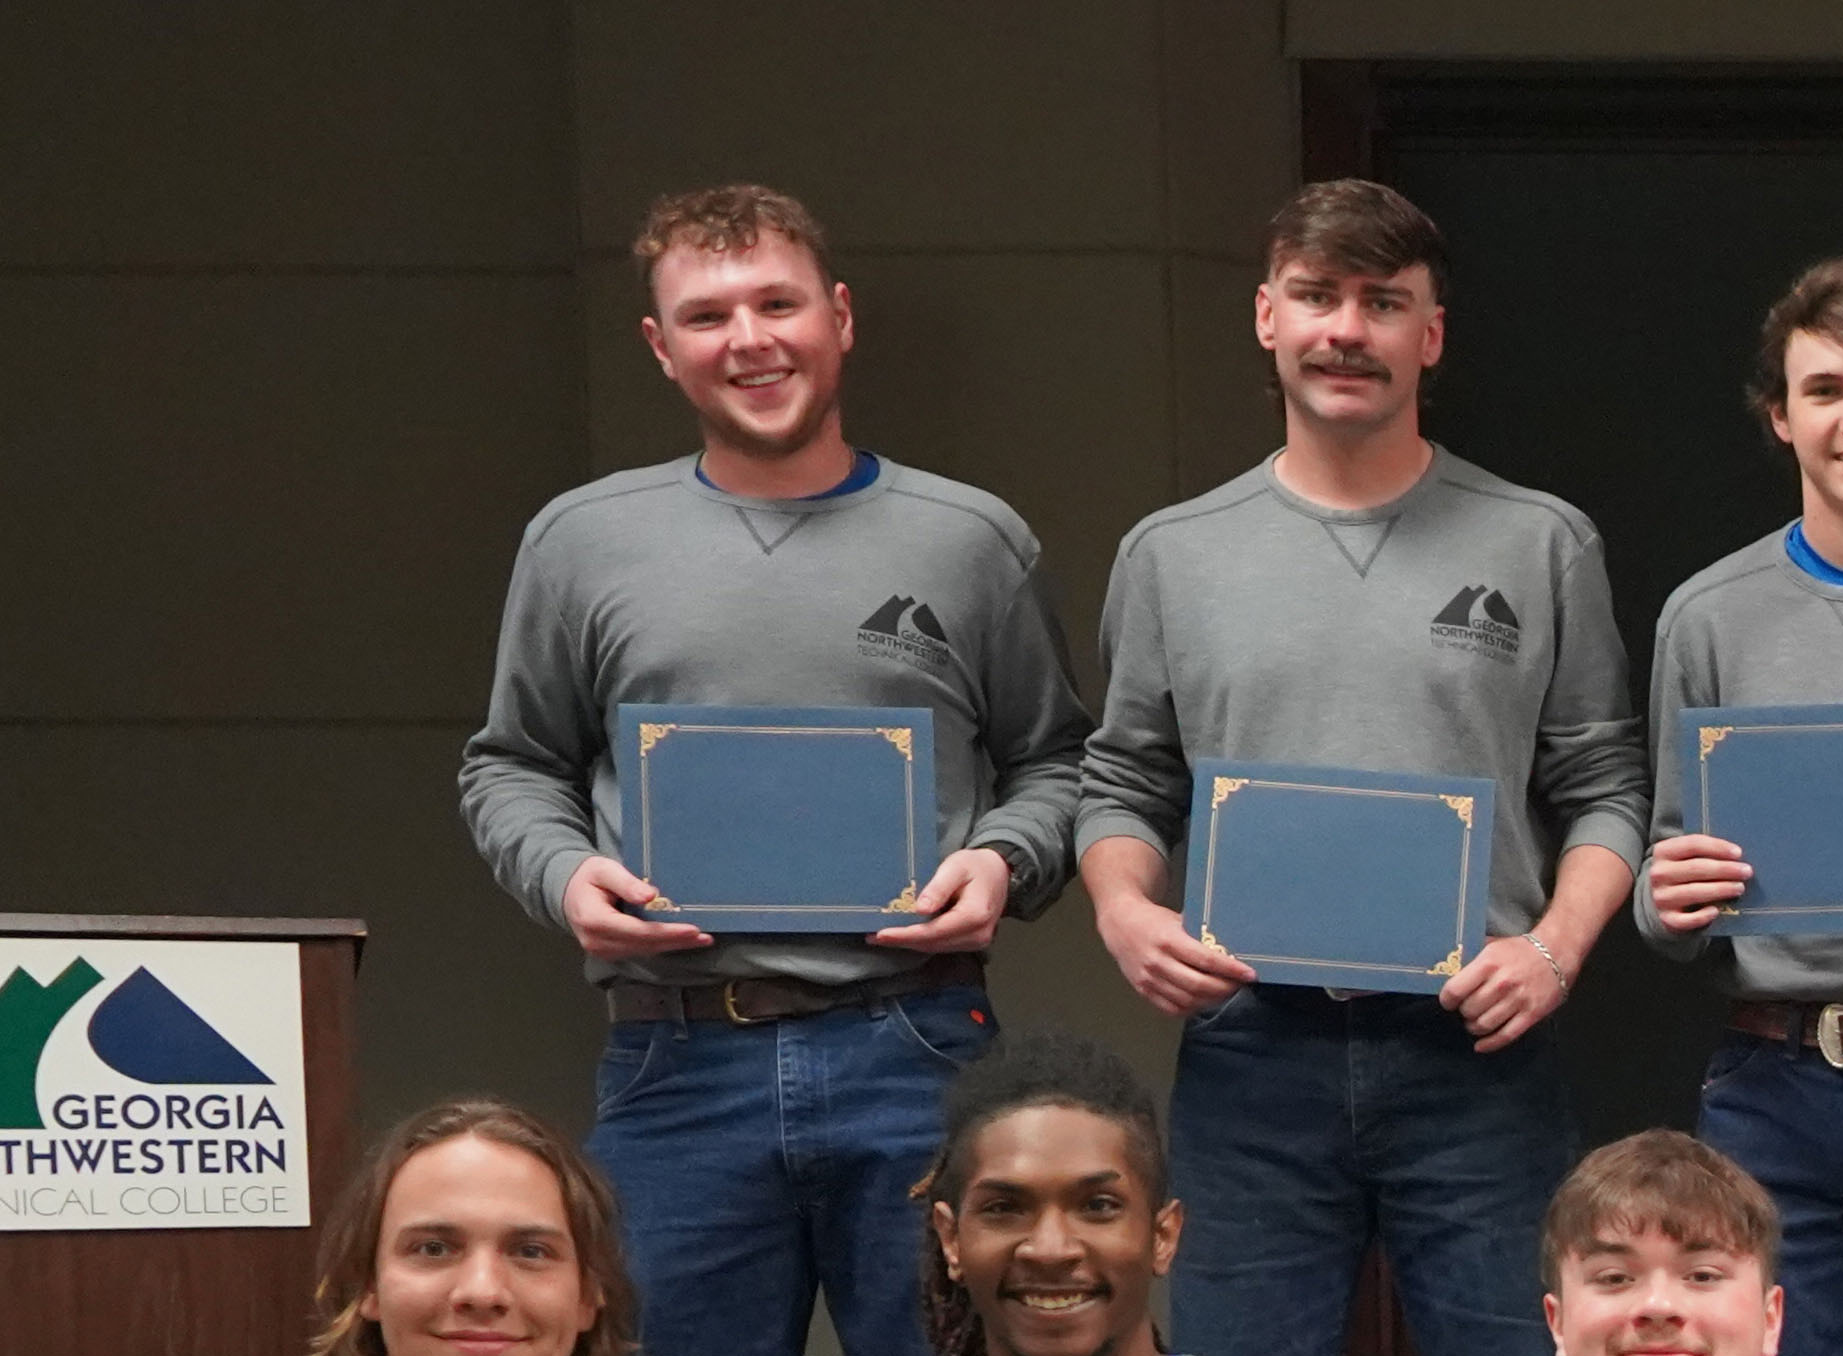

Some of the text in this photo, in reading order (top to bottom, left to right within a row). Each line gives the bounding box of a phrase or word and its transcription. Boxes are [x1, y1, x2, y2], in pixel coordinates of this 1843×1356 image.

[1430, 626, 1519, 653] NORTHWESTERN
[1471, 619, 1519, 641] GEORGIA
[52, 1094, 285, 1130] GEORGIA
[0, 1139, 287, 1175] THWESTERN
[0, 1186, 289, 1216] NICAL COLLEGE
